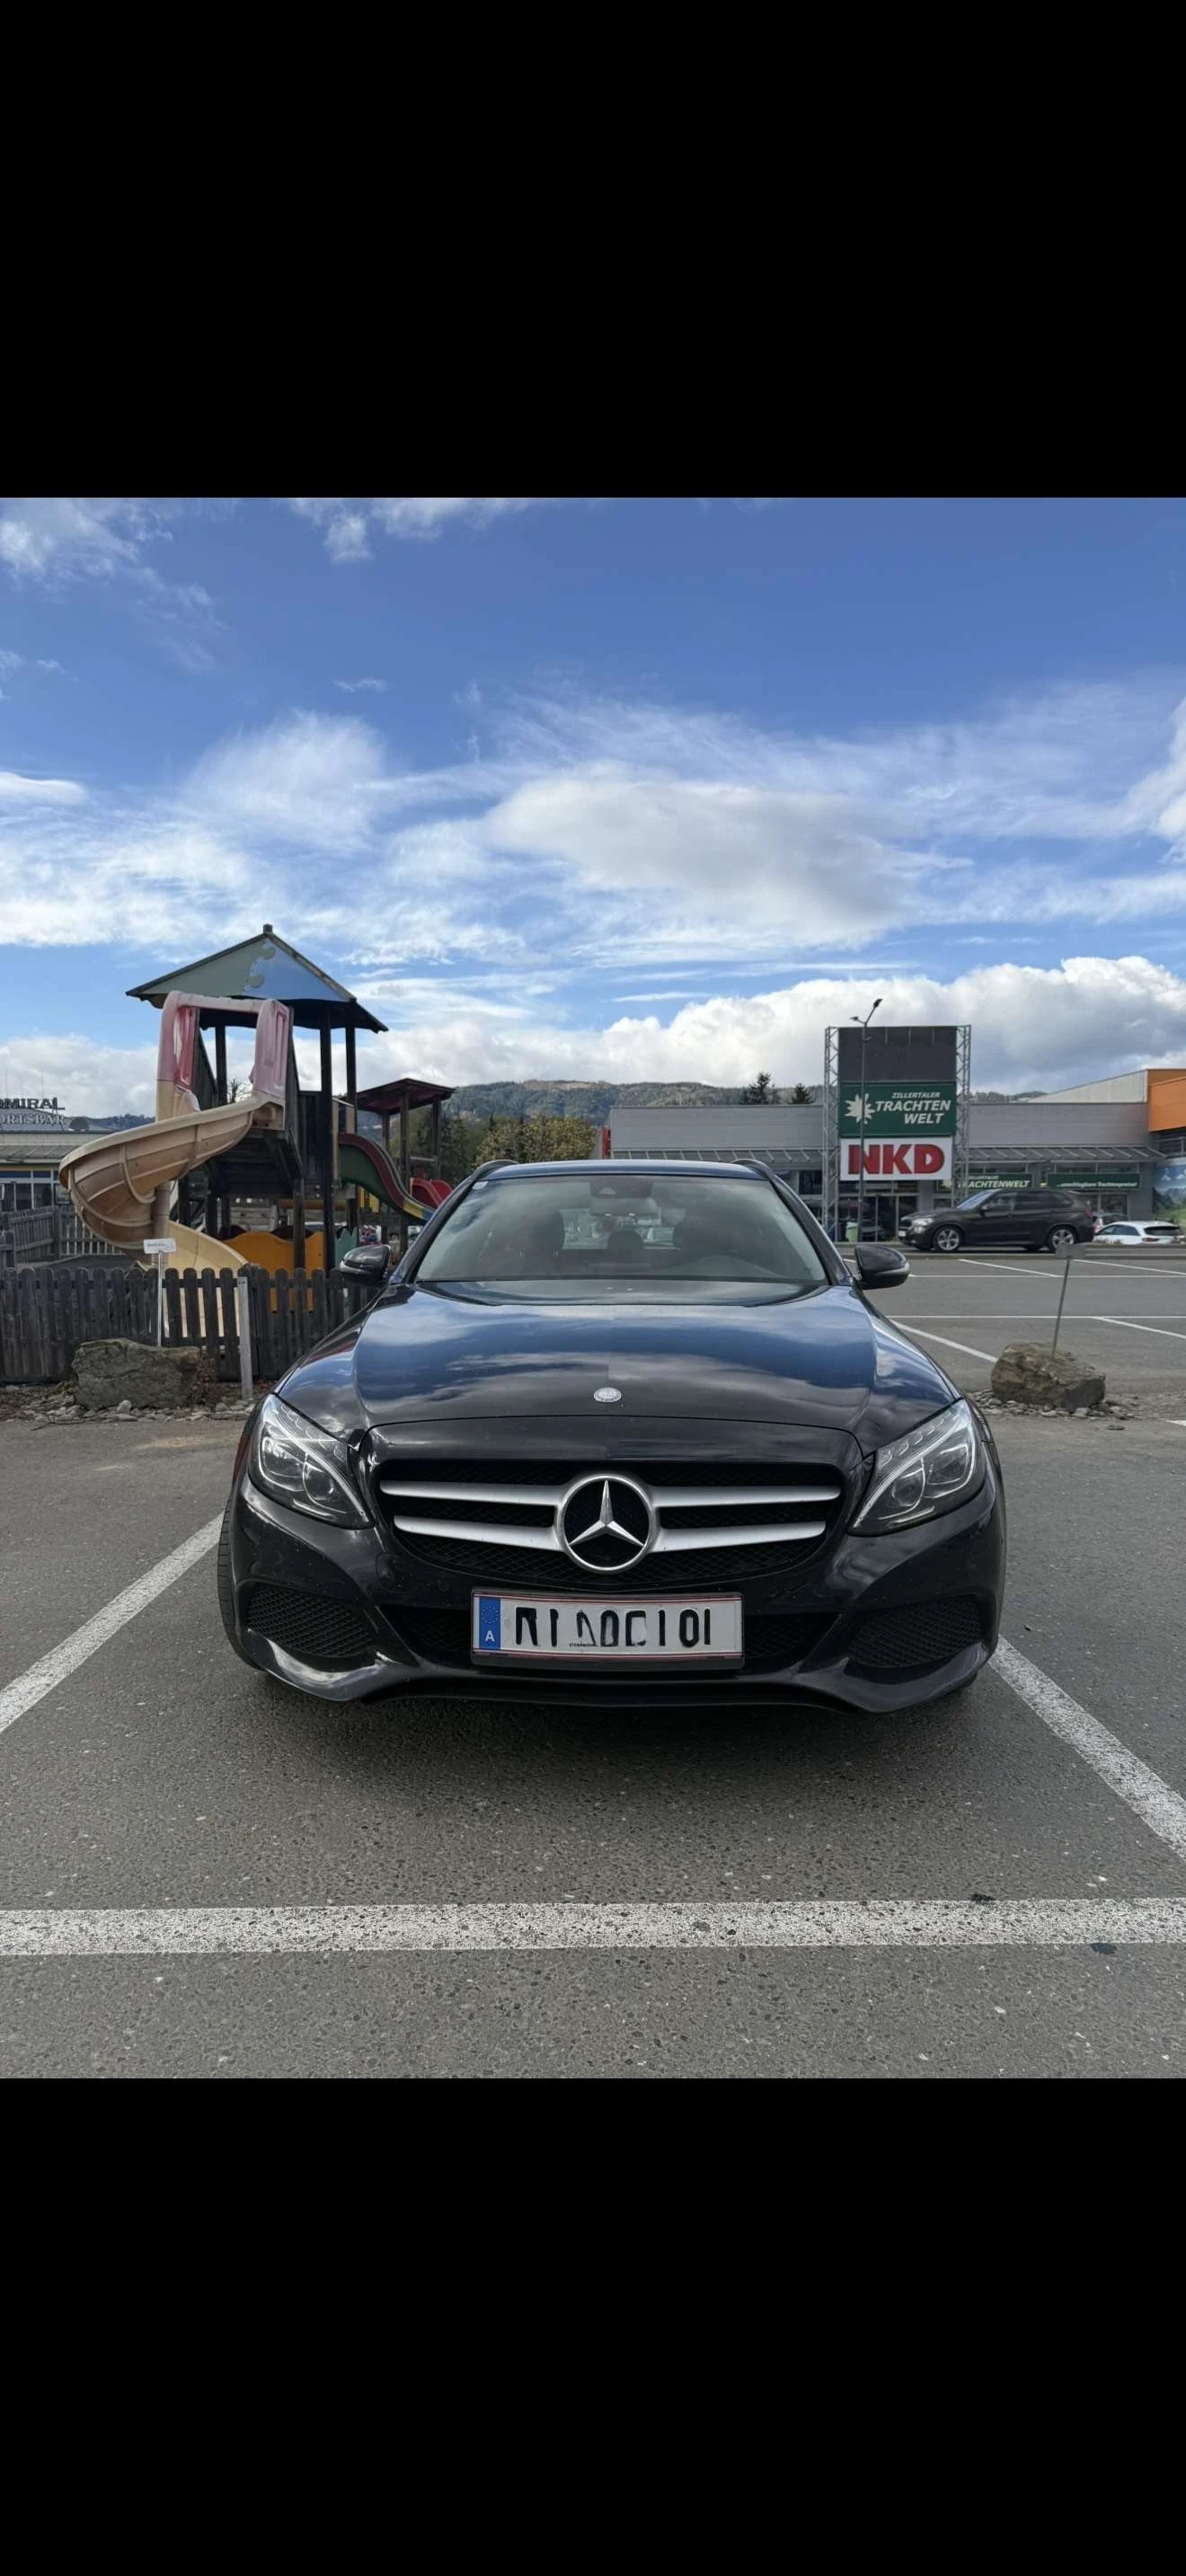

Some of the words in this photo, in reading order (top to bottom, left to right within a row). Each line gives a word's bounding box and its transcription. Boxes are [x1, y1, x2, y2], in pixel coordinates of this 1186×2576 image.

[875, 1100, 951, 1112] TRACHTEN
[904, 1113, 944, 1125] WELT
[848, 1143, 945, 1175] NKD
[484, 1630, 495, 1642] A
